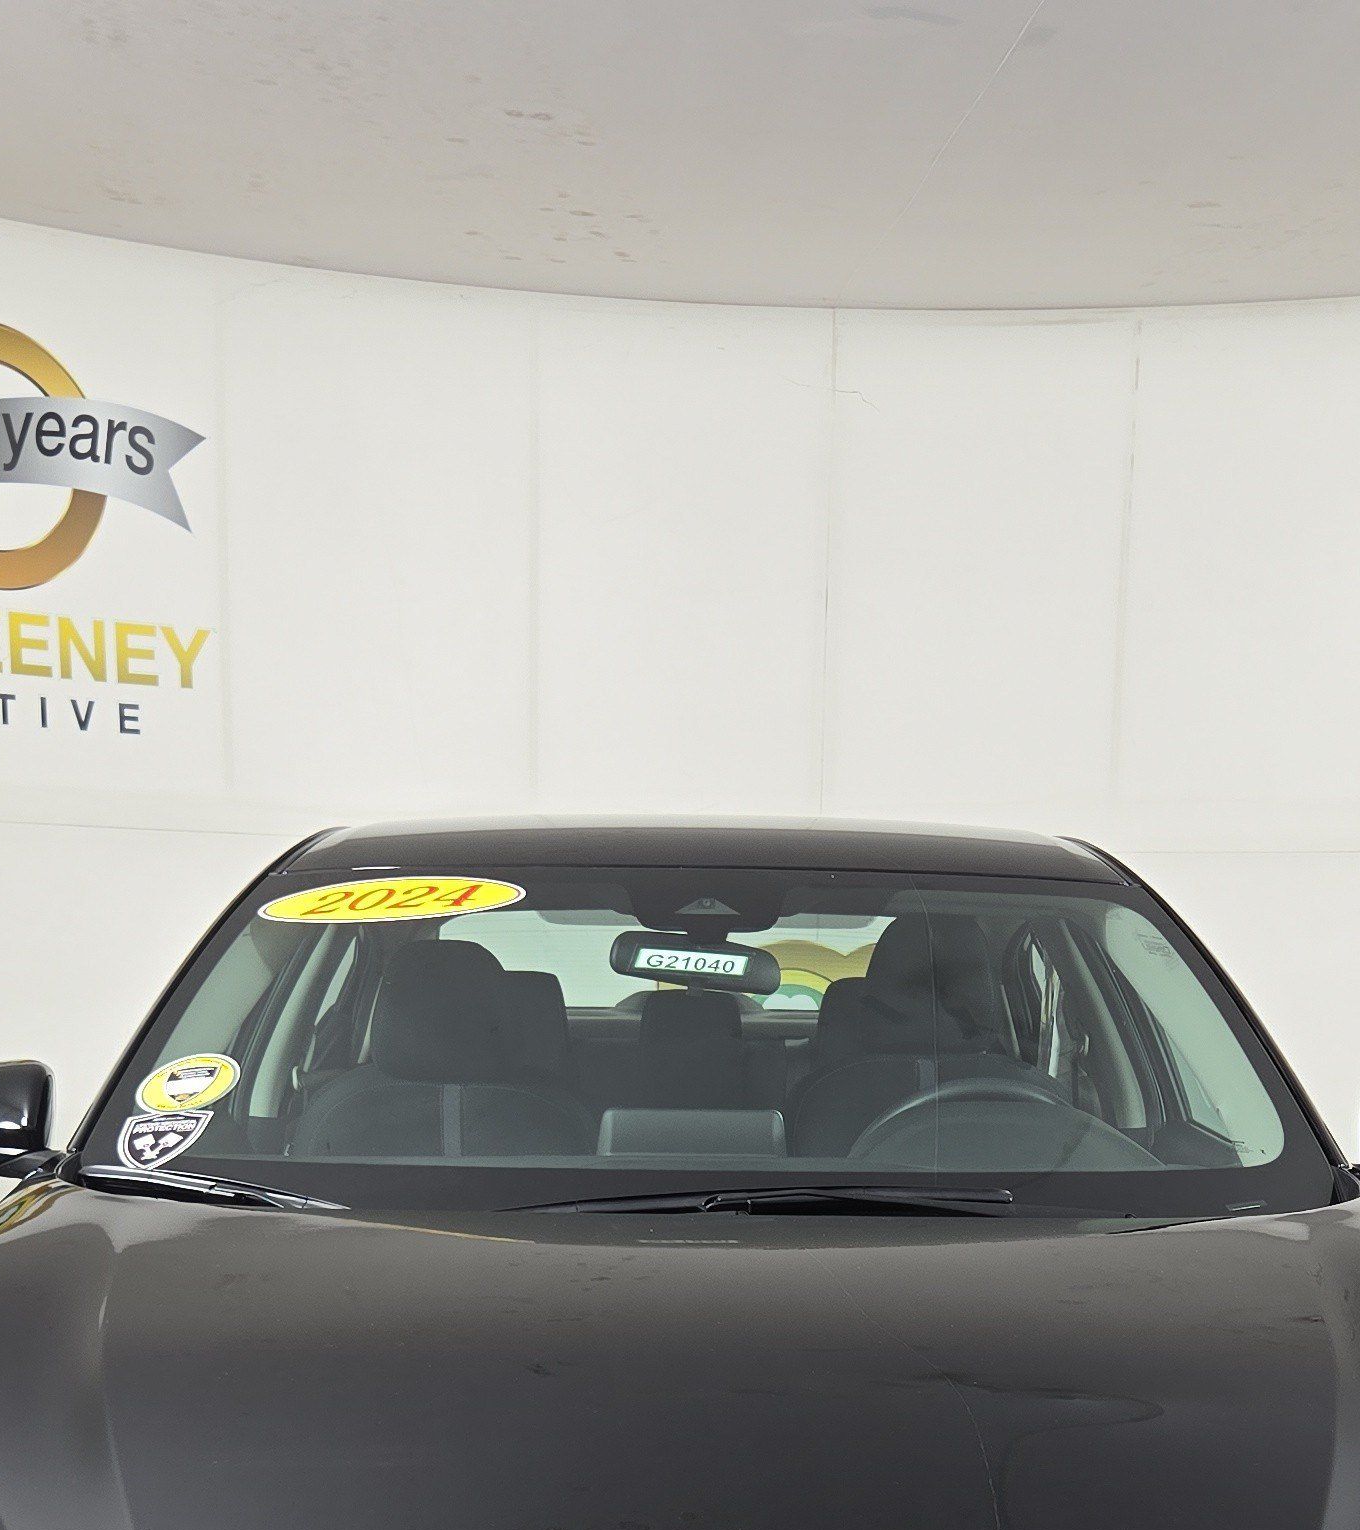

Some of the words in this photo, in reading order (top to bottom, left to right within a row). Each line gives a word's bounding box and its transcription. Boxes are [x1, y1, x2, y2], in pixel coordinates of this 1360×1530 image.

[1, 409, 155, 475] years
[300, 884, 483, 916] 2024
[646, 954, 735, 973] G21040
